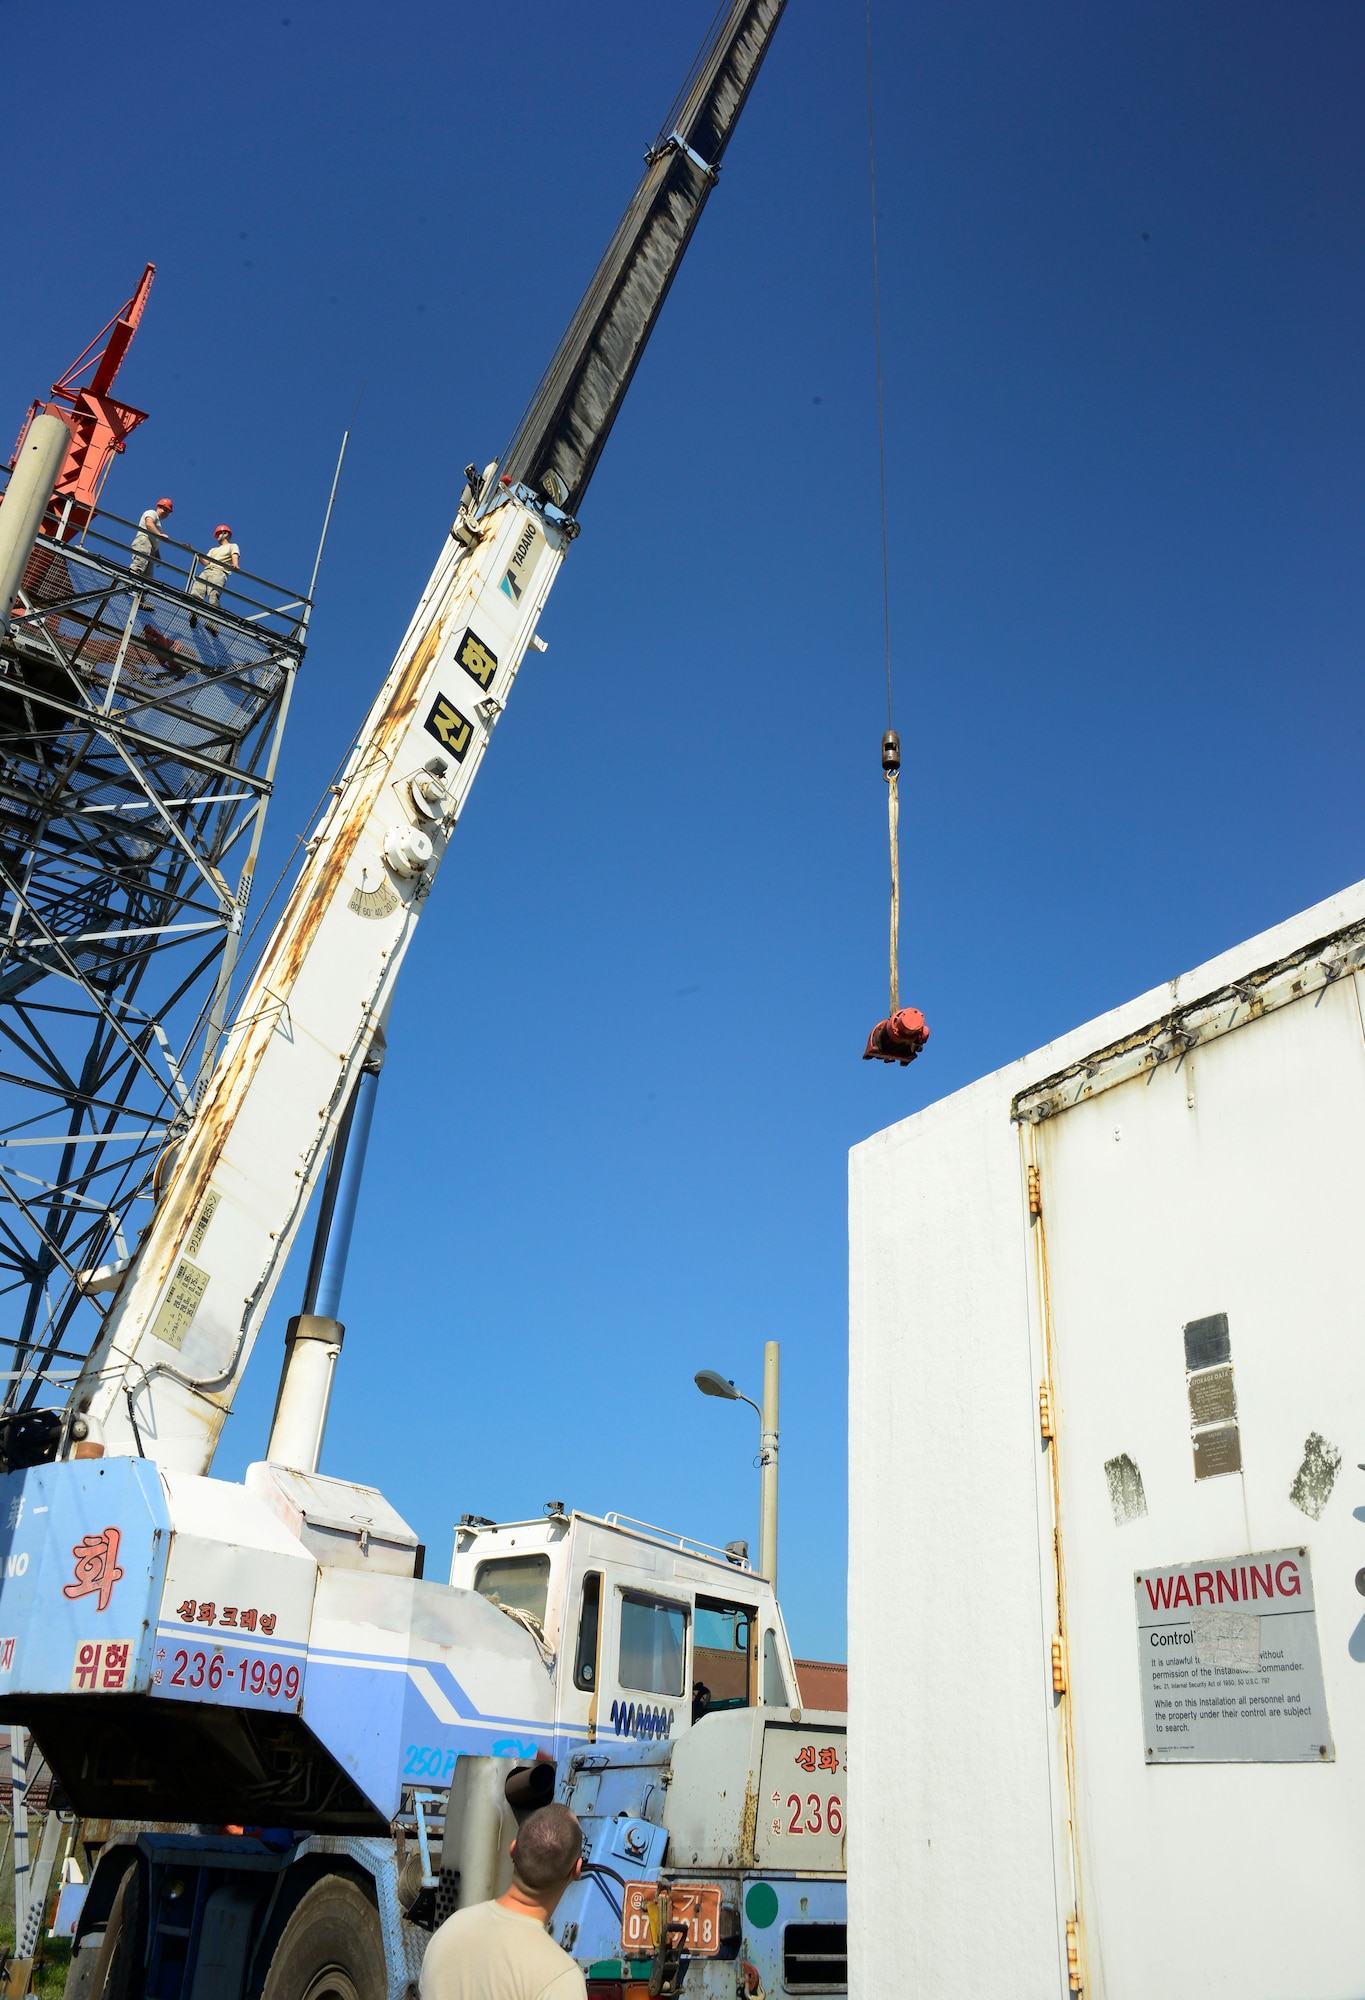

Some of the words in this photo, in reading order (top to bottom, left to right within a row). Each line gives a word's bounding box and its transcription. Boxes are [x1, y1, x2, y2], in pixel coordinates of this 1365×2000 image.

[511, 524, 537, 568] TADANO
[1191, 1375, 1214, 1386] STORAGE
[1214, 1371, 1229, 1380] DATA
[62, 1526, 124, 1613] 화
[1145, 1560, 1302, 1610] WARNING
[176, 1600, 216, 1626] 신화
[219, 1607, 277, 1635] 크레인
[75, 1644, 130, 1689] 위험
[169, 1649, 300, 1700] 236-1999
[1151, 1659, 1156, 1667] It
[1158, 1658, 1164, 1667] is
[1166, 1656, 1193, 1666] unlawful
[1152, 1669, 1189, 1680] permission
[1191, 1668, 1198, 1677] of
[1200, 1668, 1212, 1676] the
[1189, 1681, 1207, 1689] Security
[1154, 1699, 1172, 1708] While
[1174, 1699, 1183, 1707] on
[1185, 1698, 1197, 1707] this
[1199, 1697, 1236, 1706] Installation
[1238, 1696, 1247, 1705] all
[1249, 1694, 1284, 1706] personnel
[1286, 1693, 1301, 1703] and
[1155, 1711, 1166, 1720] the
[1168, 1710, 1197, 1721] property
[1199, 1710, 1219, 1719] under
[1221, 1709, 1238, 1718] their
[1240, 1707, 1266, 1717] control
[1269, 1708, 1281, 1717] are
[1283, 1706, 1312, 1717] subject
[1156, 1724, 1163, 1732] to
[1165, 1723, 1190, 1732] search.
[794, 1746, 840, 1774] 신화
[786, 1791, 843, 1837] 236
